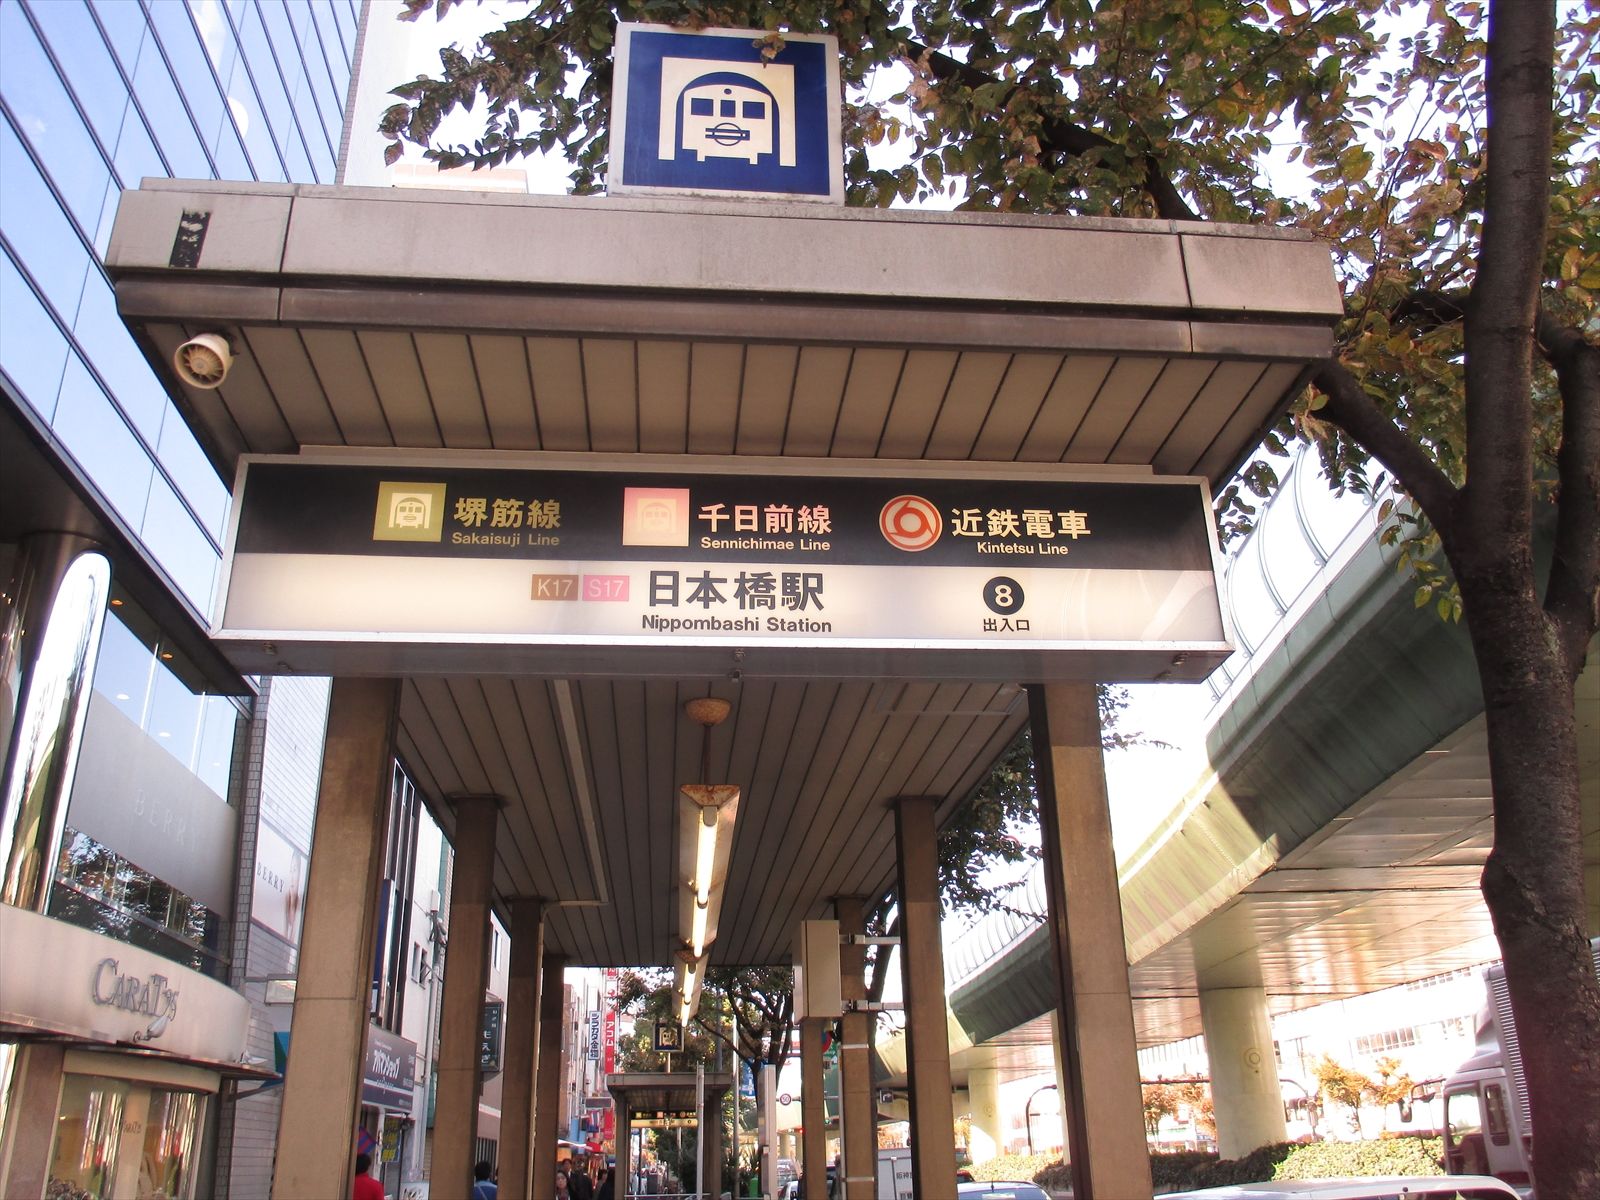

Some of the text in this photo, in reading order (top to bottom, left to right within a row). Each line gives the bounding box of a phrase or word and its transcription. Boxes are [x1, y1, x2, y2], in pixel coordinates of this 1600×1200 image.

[453, 497, 561, 529] 堺筋線
[699, 503, 832, 535] 千日前線
[951, 508, 1091, 539] 近鉄電車
[452, 532, 560, 547] Sakaisuji Line
[701, 537, 831, 551] Sennichimae Line
[977, 541, 1069, 555] Kintetsu Line
[537, 578, 574, 597] K17
[589, 579, 625, 598] S17
[649, 570, 825, 611] 日本橋駅
[994, 584, 1014, 607] 8
[642, 614, 832, 632] Nippombashi Station
[983, 618, 1030, 632] 出入口
